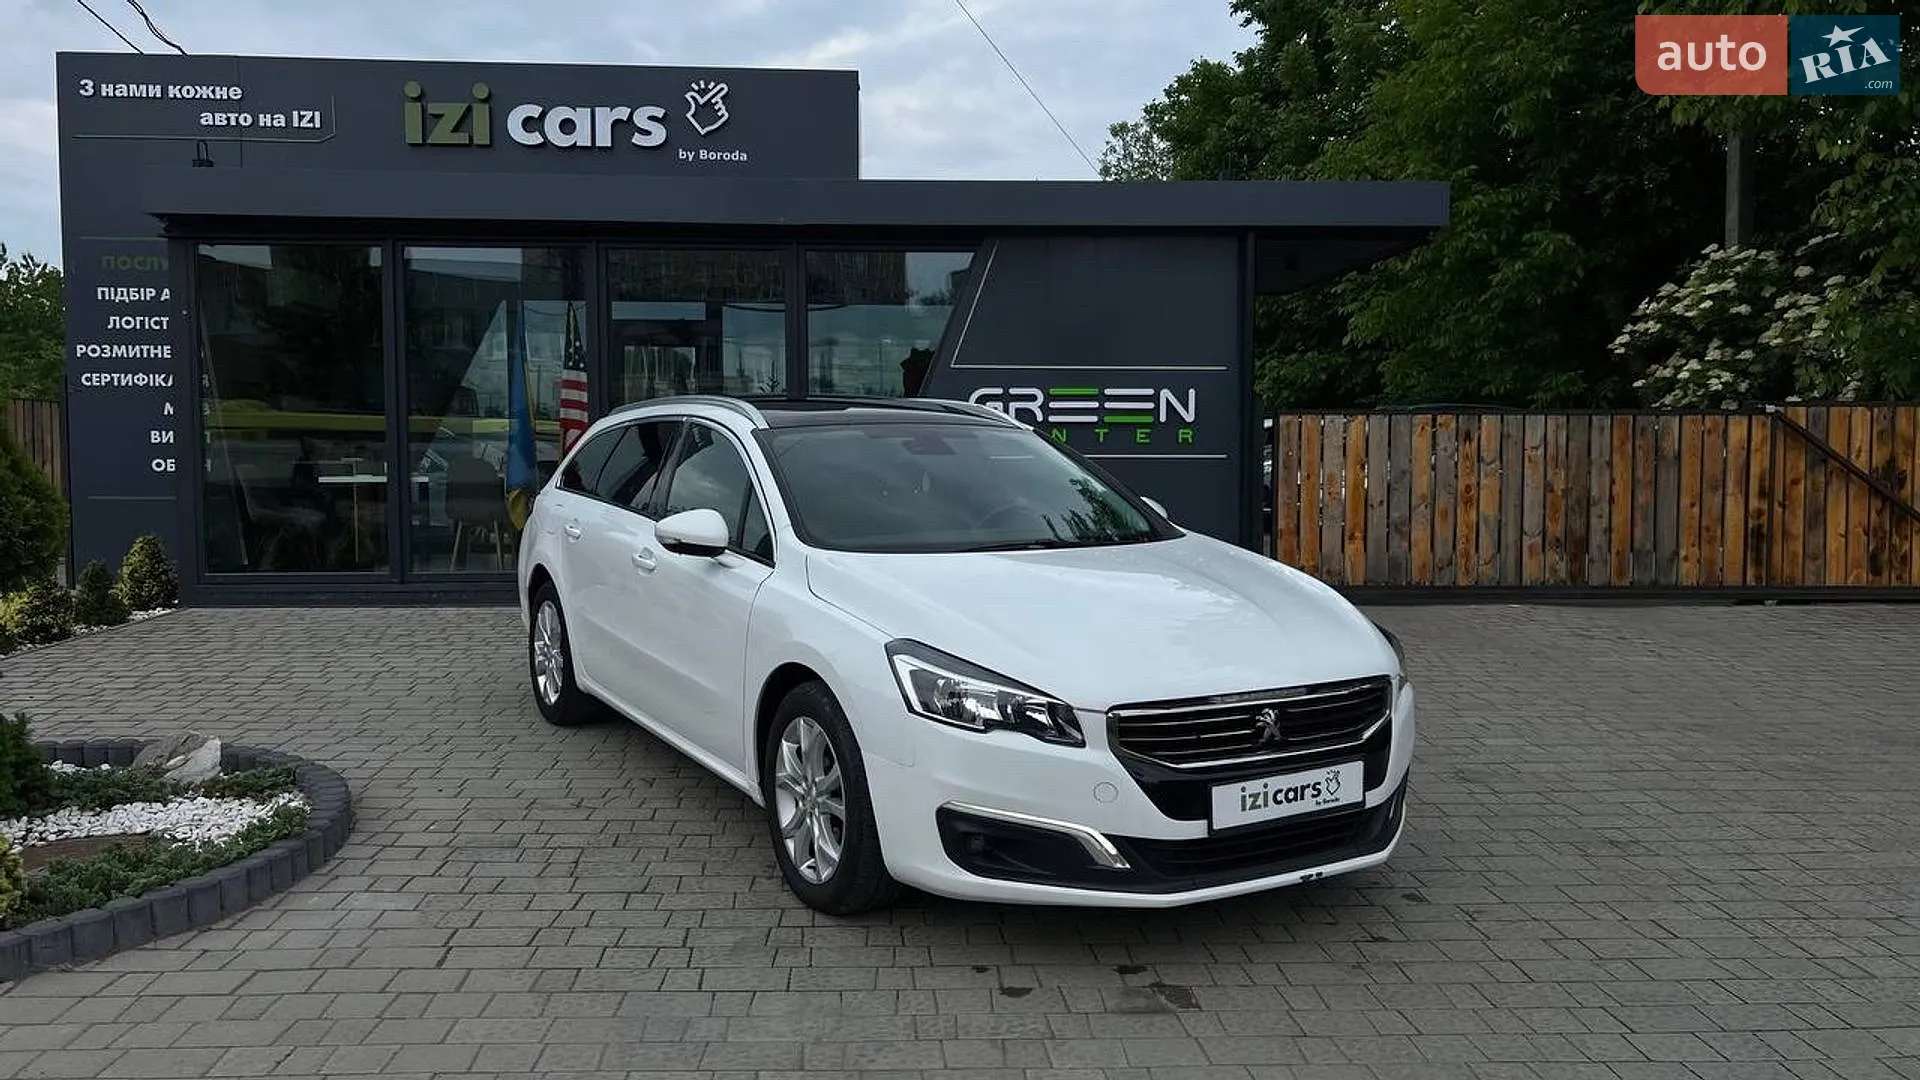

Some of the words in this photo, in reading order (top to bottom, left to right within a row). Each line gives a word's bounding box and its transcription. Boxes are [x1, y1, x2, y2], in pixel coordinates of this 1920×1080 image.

[79, 80, 94, 97] З
[101, 82, 162, 98] нами
[167, 84, 243, 101] кожне
[200, 110, 253, 127] авто
[259, 112, 286, 128] на
[292, 111, 321, 129] IZI
[404, 81, 491, 146] izi
[507, 103, 667, 147] cars
[679, 149, 694, 161] by
[700, 150, 747, 161] Boroda
[97, 287, 156, 302] ПІДБІР
[107, 316, 169, 330] ЛОГІСТ
[76, 345, 172, 359] РОЗМИТНЕ
[969, 387, 1196, 422] GREEN
[1240, 782, 1269, 812] izi
[1272, 781, 1322, 805] cars
